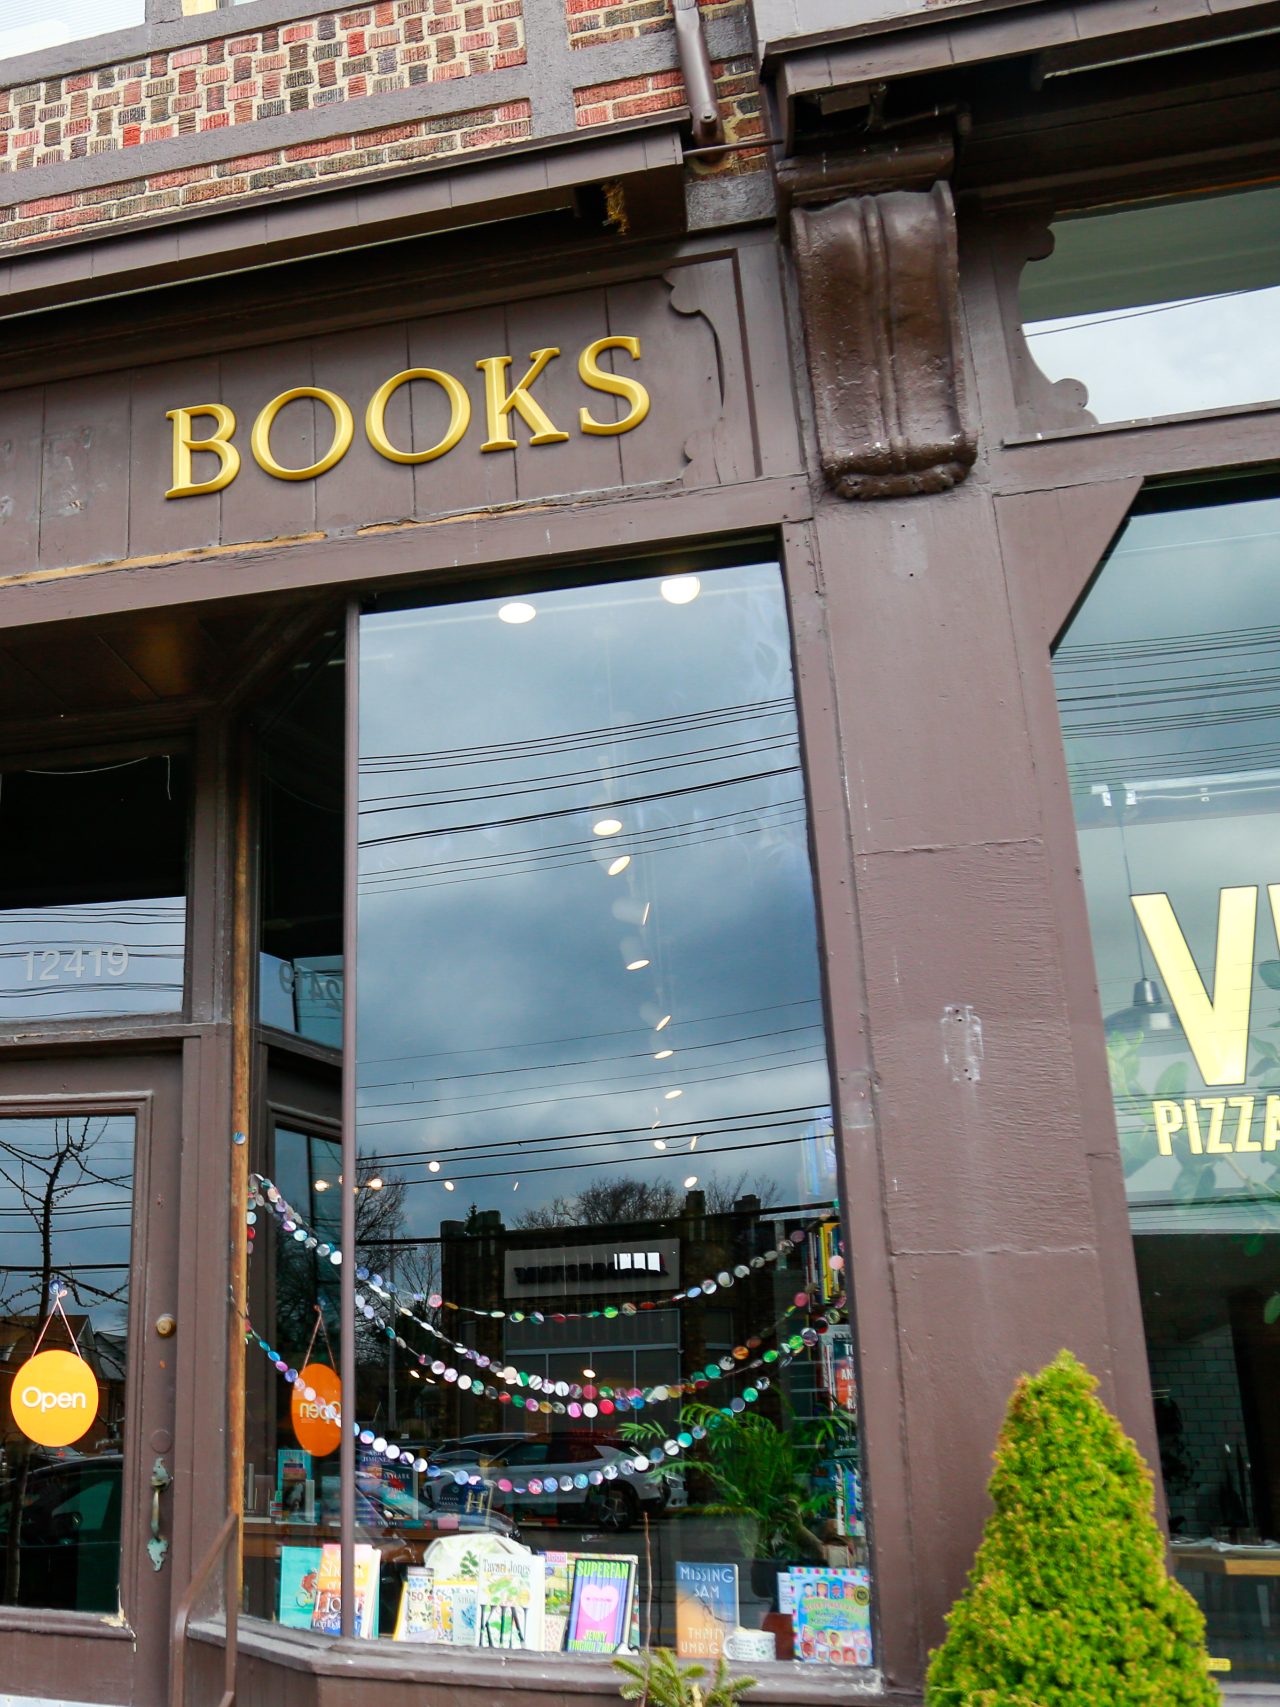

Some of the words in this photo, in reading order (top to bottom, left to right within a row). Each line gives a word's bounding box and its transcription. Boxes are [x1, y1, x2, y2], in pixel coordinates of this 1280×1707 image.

[165, 335, 650, 500] BOOKS
[23, 944, 129, 981] 12419
[22, 1386, 86, 1413] Open
[508, 1560, 531, 1574] Jones
[576, 1560, 629, 1579] SUPERFAN
[680, 1566, 735, 1583] MISSING
[694, 1584, 720, 1599] SAM
[479, 1604, 529, 1648] KIN
